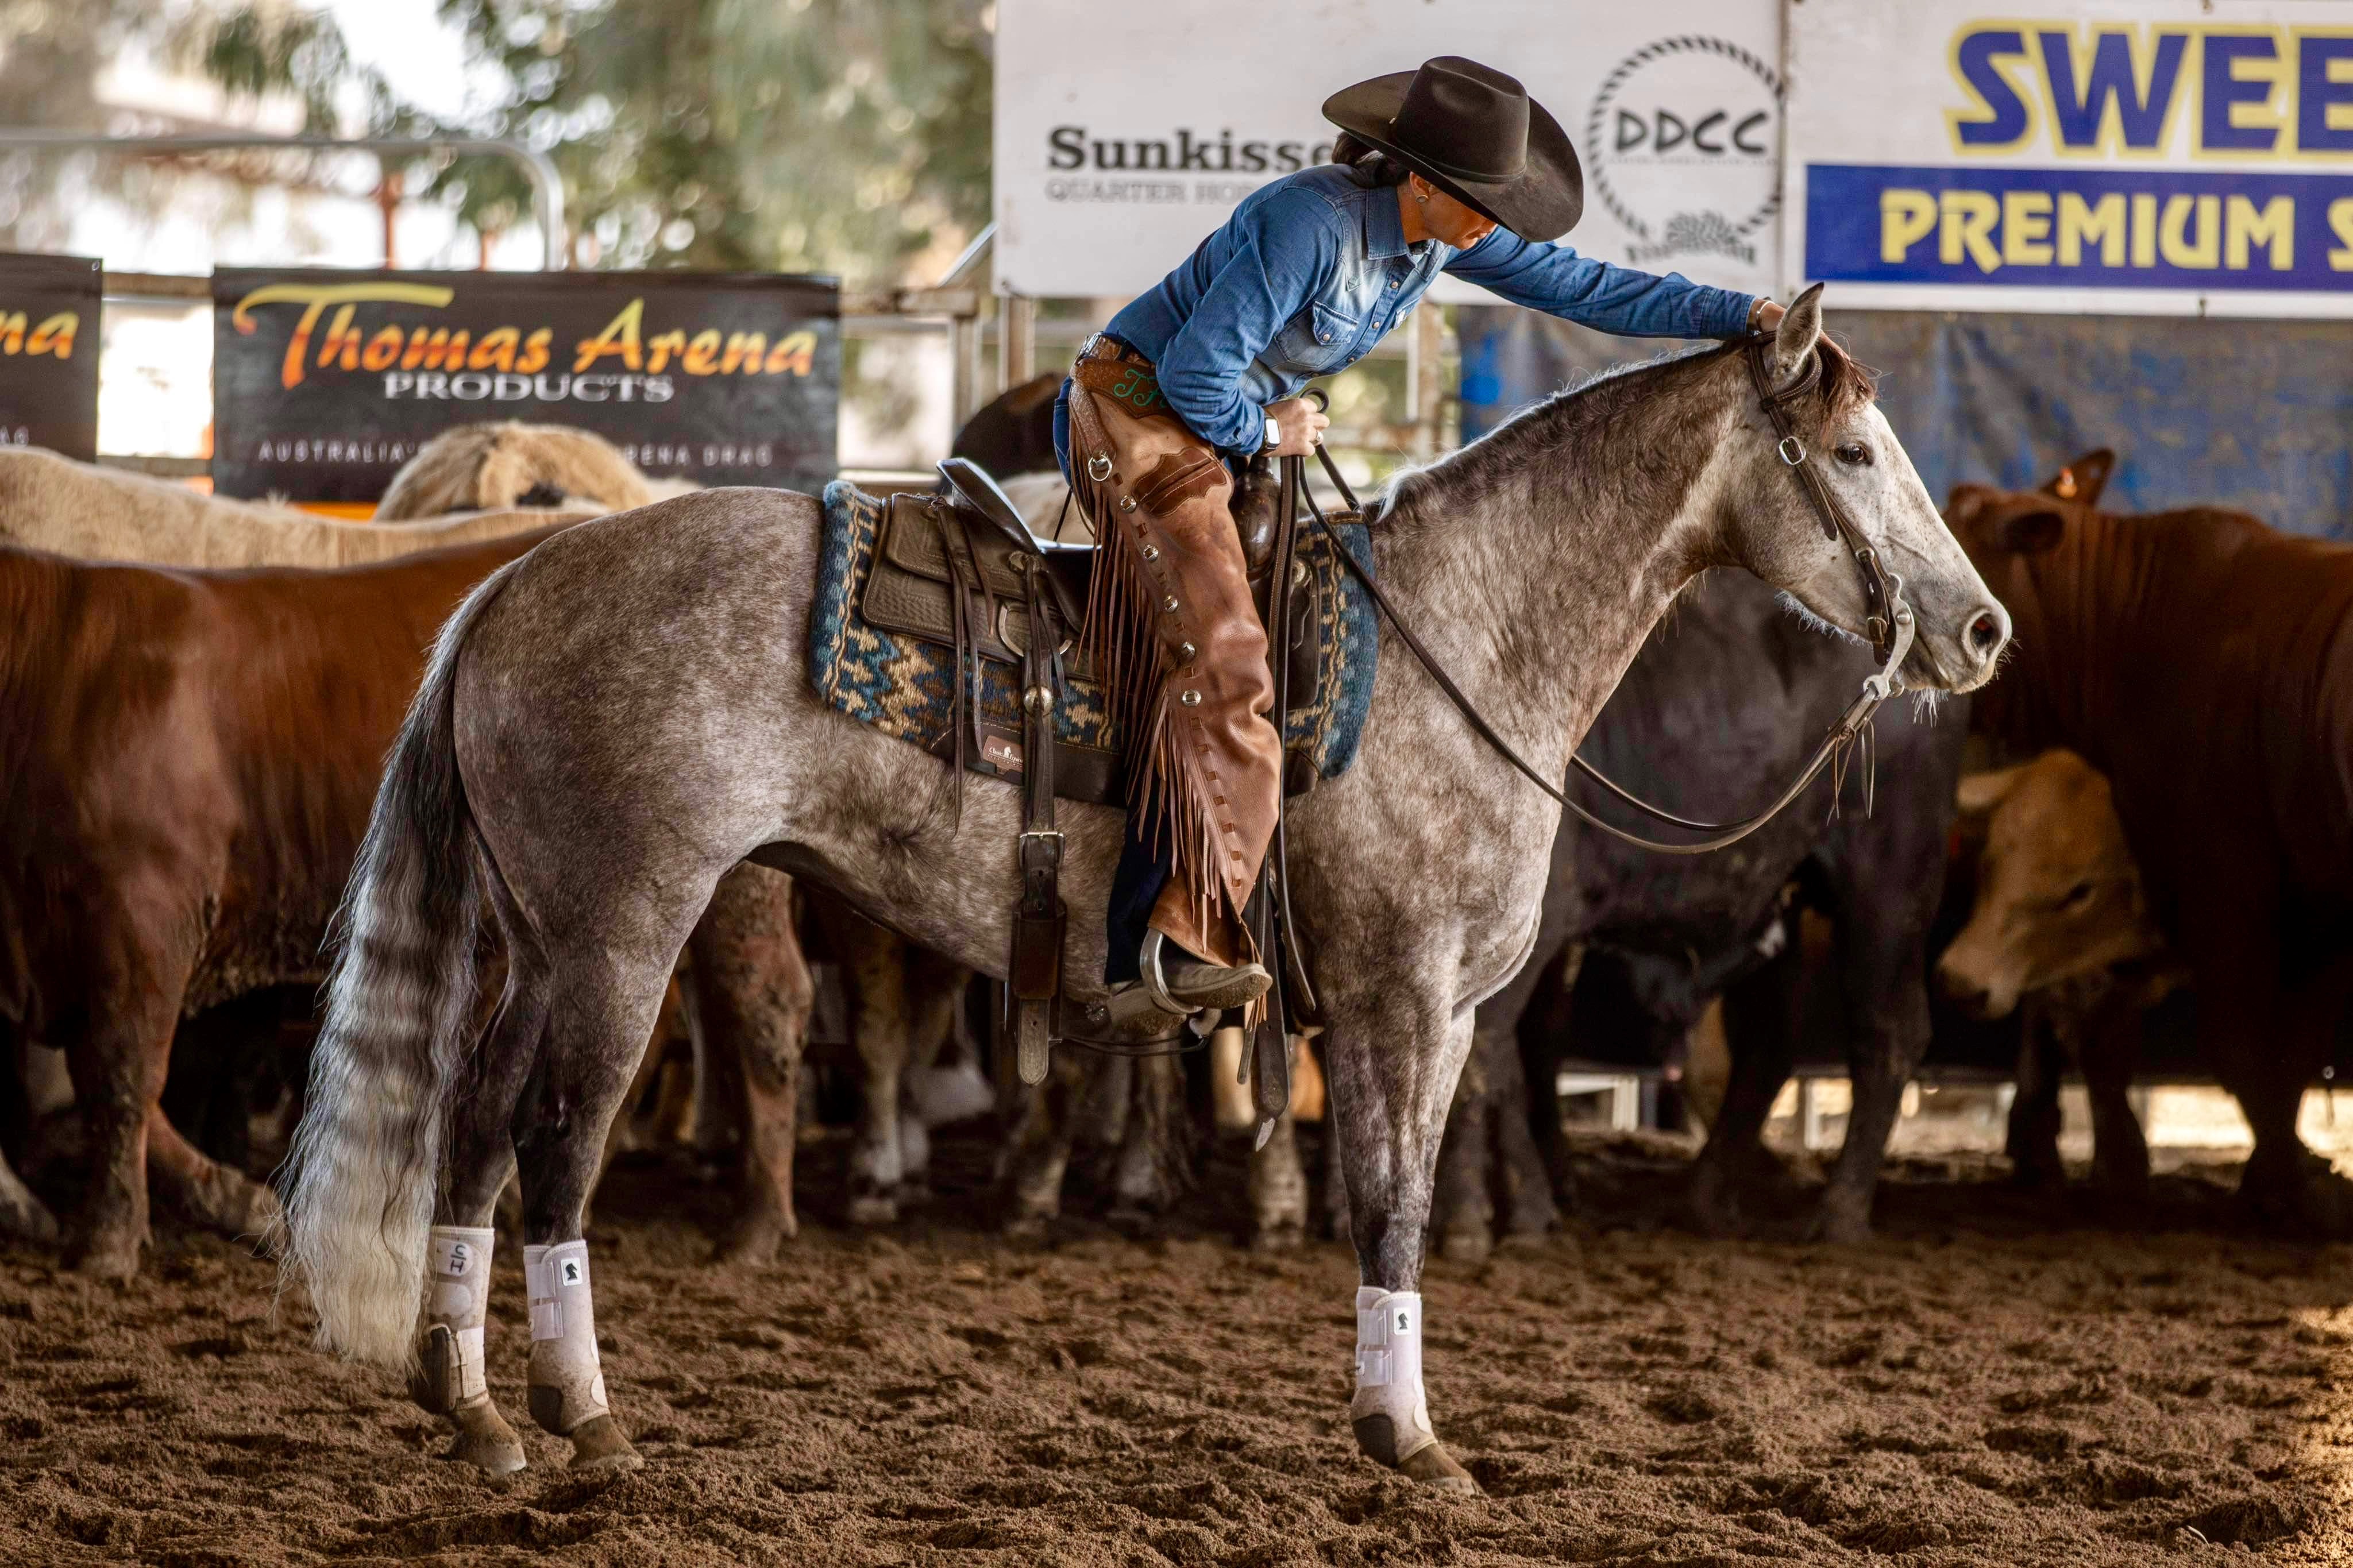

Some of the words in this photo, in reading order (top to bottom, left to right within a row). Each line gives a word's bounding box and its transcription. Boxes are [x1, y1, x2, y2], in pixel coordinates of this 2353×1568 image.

[1615, 108, 1768, 155] DDCC
[1943, 18, 2353, 160] SWEE
[1879, 187, 2296, 275] PREMIUM
[233, 281, 553, 389] Thomas
[574, 297, 819, 377] Arena
[384, 372, 675, 402] PRODUCTS
